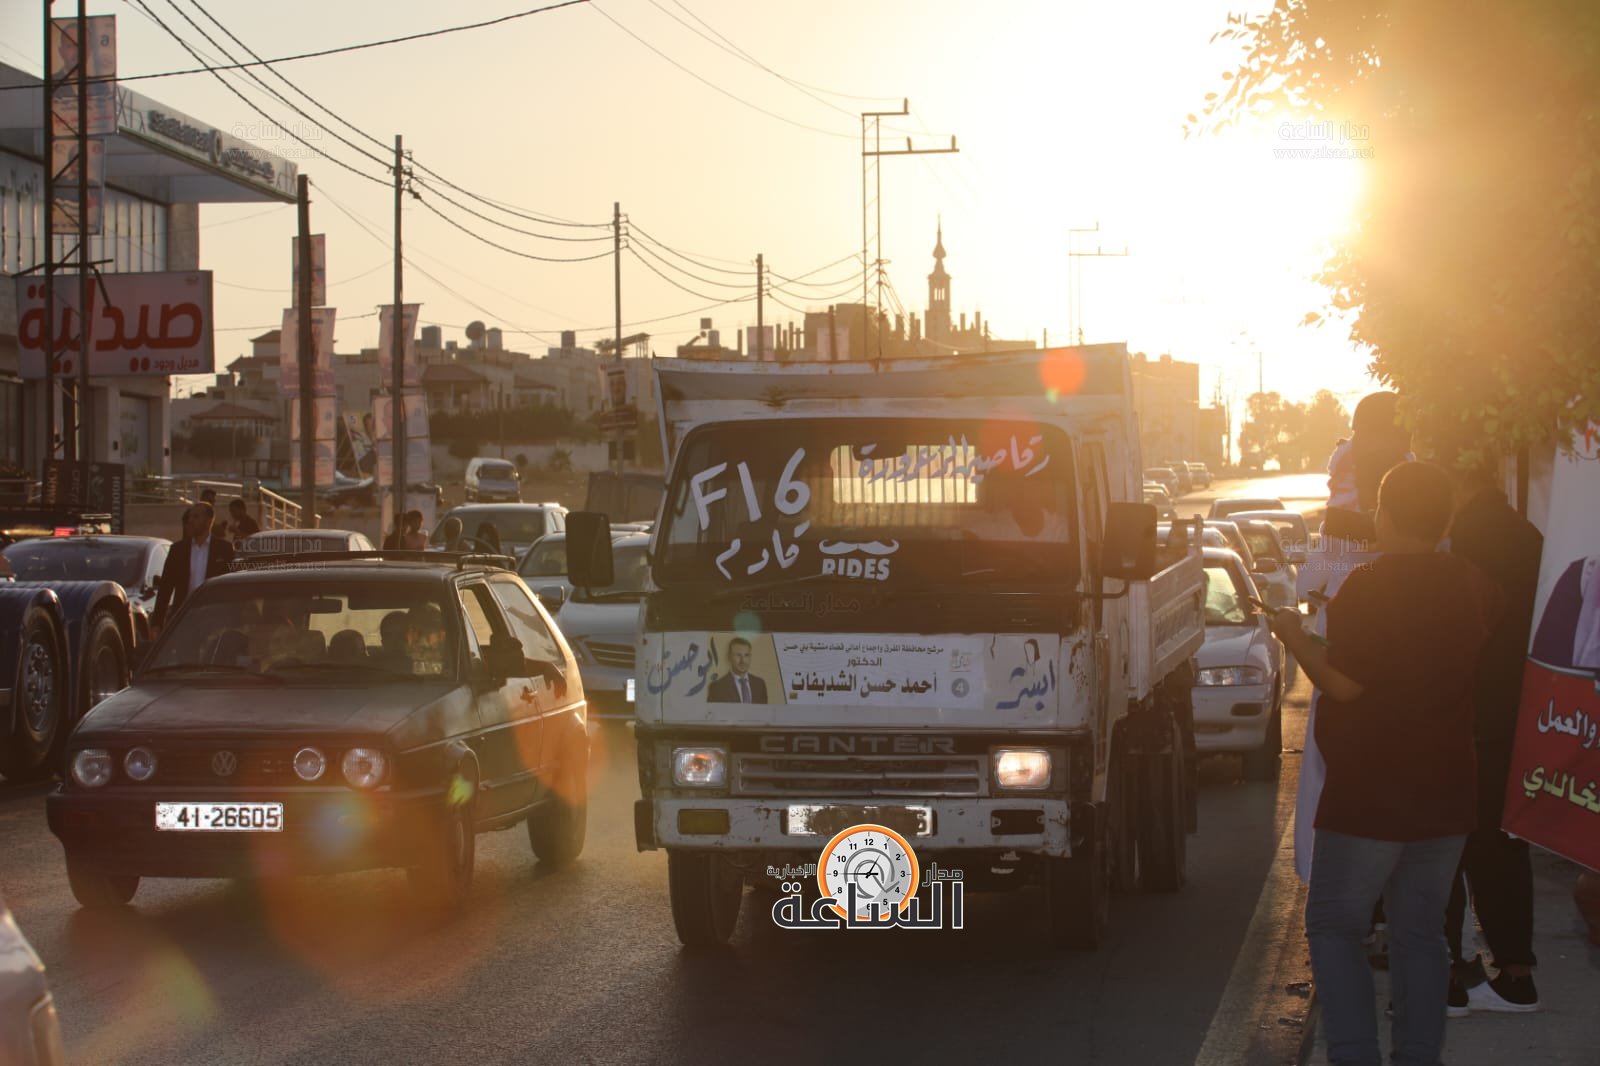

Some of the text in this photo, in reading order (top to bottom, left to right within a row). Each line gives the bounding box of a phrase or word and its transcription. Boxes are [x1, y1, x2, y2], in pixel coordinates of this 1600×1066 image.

[19, 278, 203, 375] صيدلية
[716, 520, 810, 580] قادم
[847, 657, 882, 668] الدكتور
[791, 670, 937, 698] أحمد حسن الشديفات
[1537, 699, 1598, 749] والعمل
[760, 736, 957, 754] CANTER
